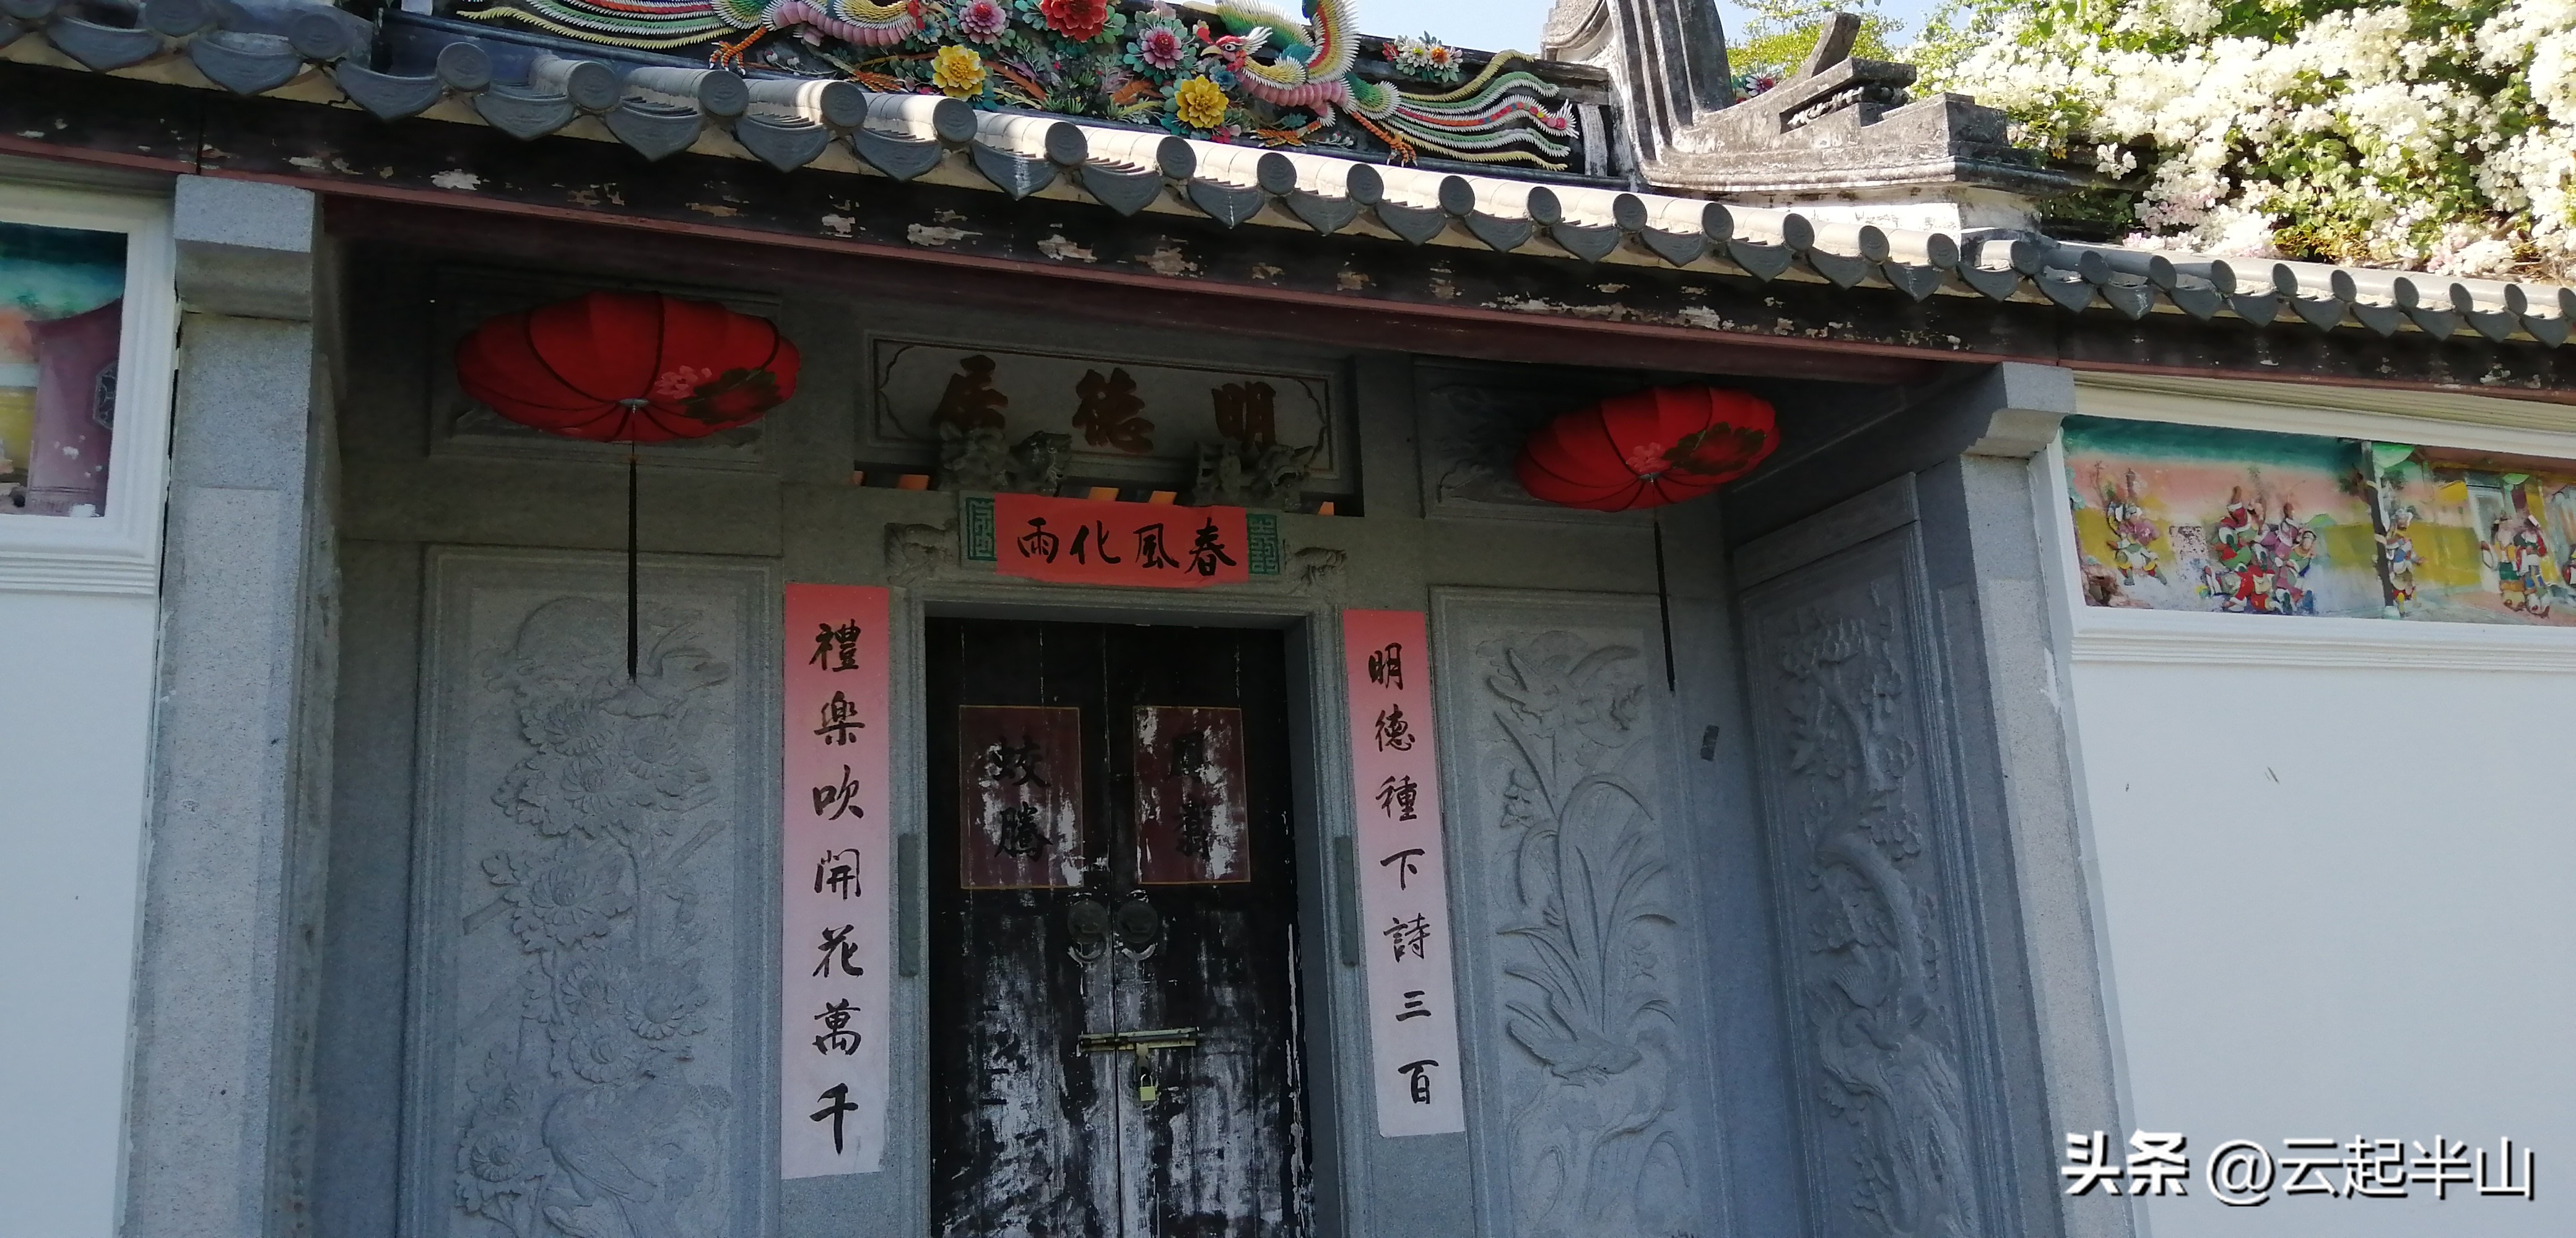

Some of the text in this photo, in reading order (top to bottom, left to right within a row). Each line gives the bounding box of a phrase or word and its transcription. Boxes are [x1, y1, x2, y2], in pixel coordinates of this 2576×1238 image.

[1017, 517, 1237, 576] 春風化雨
[1368, 642, 1440, 1104] 明德種下詩三百
